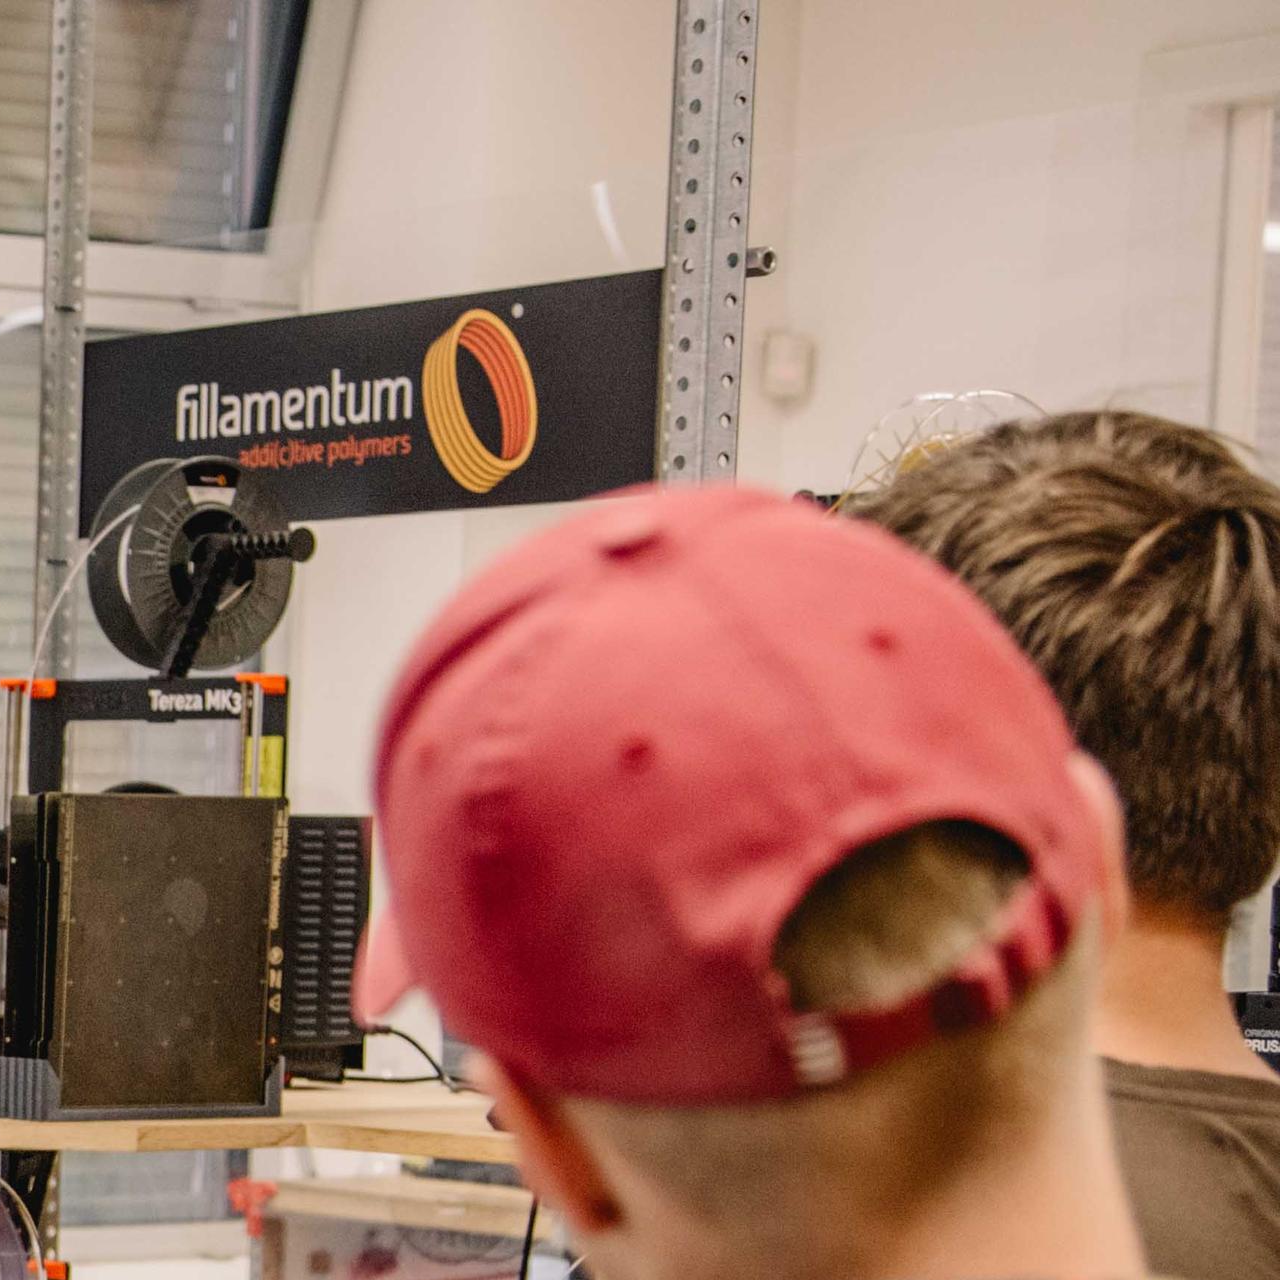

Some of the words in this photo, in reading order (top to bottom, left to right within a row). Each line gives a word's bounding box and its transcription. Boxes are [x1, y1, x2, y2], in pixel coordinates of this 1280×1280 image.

[176, 369, 413, 442] fillamentum
[240, 439, 324, 469] addi(c)tive
[326, 433, 412, 469] polymers
[148, 688, 203, 712] Tereza
[205, 688, 252, 714] MK3
[1244, 1029, 1280, 1039] ORIGINA
[1244, 1039, 1280, 1053] PRUS
